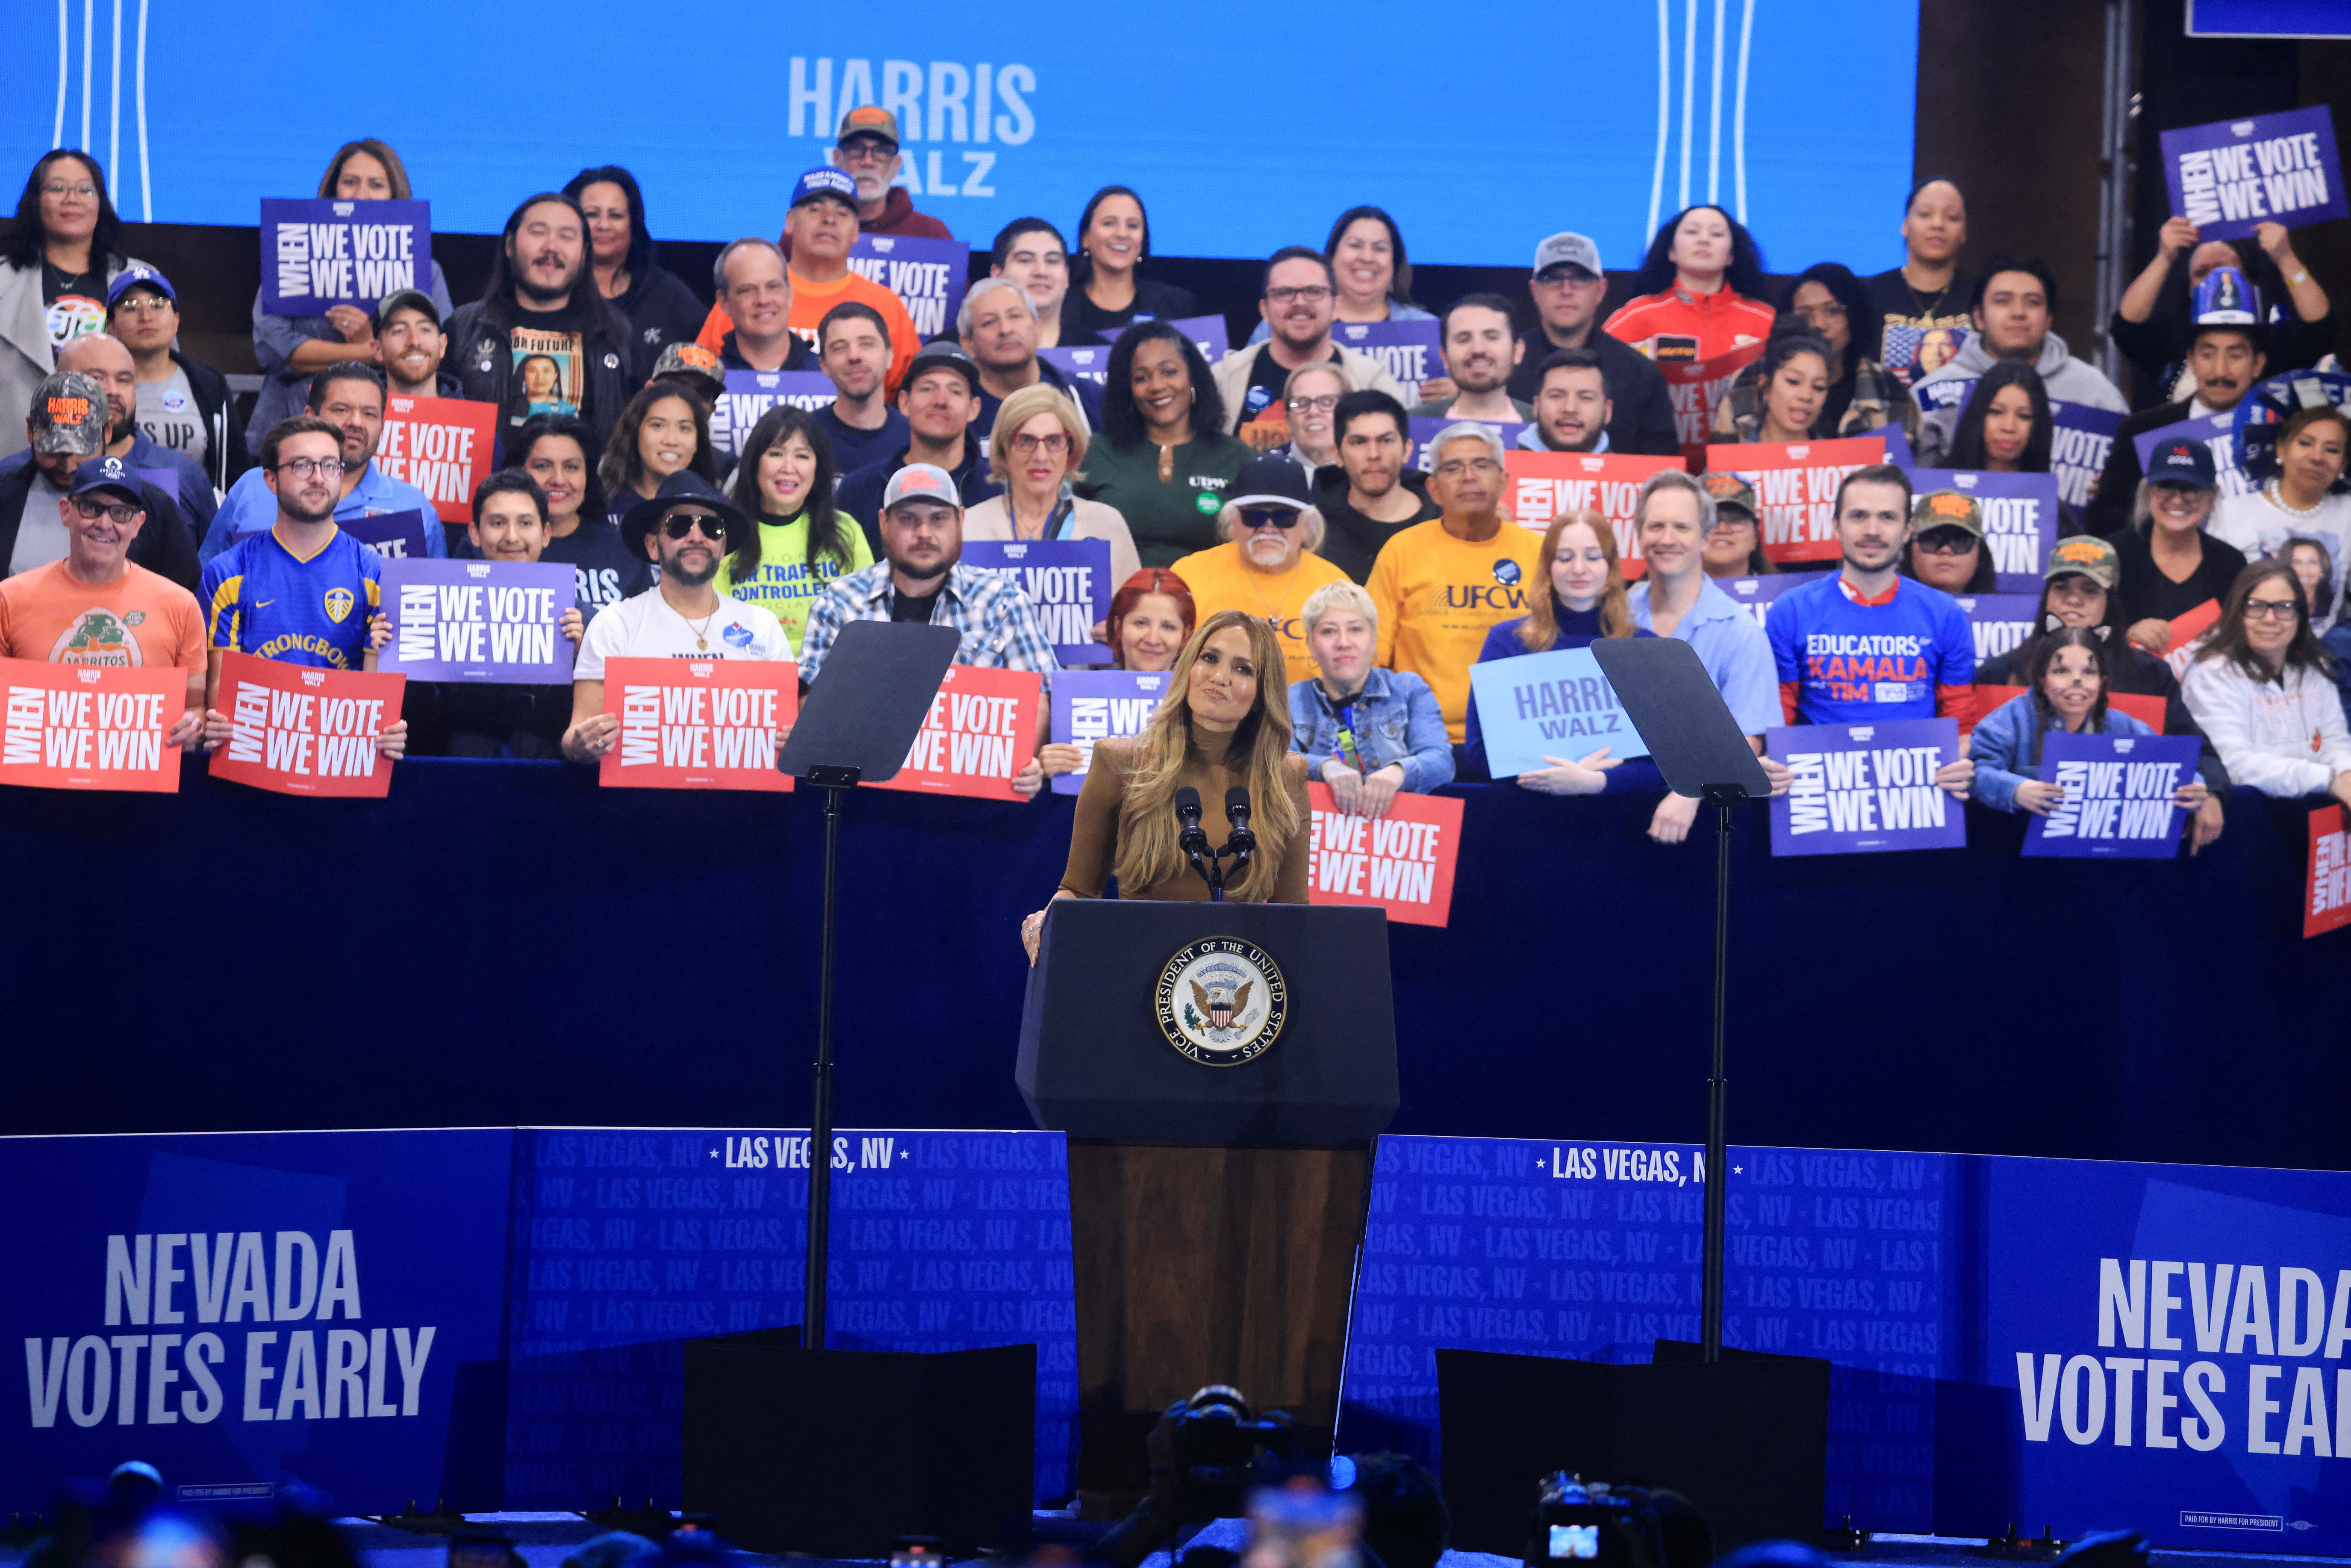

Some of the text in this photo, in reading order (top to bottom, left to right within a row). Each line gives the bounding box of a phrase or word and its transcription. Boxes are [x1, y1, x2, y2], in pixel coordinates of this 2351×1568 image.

[788, 56, 1037, 145] HARRIS
[2211, 132, 2319, 182] WE VOTE
[2179, 150, 2222, 227] WHEN
[2217, 167, 2330, 222] WE WIN
[277, 223, 309, 298] WHEN
[309, 224, 413, 260] WE VOTE
[310, 260, 414, 299] WE WIN
[890, 261, 951, 297] VOTE
[47, 397, 89, 415] HARRIS
[53, 414, 82, 424] WALZ
[165, 423, 194, 450] UP
[410, 422, 475, 463] VOTE
[410, 459, 471, 504] WIN
[1763, 468, 1803, 505] WE
[1516, 478, 1553, 536] HEN
[1763, 504, 1806, 544] WE
[467, 564, 490, 573] HARRIS
[1025, 566, 1093, 604] VOTE
[439, 586, 555, 624] WE VOTE
[1447, 585, 1532, 609] UFCW
[398, 584, 437, 662] WHEN
[438, 622, 554, 664] WE WIN
[1807, 634, 1920, 656] EDUCATORS
[77, 669, 101, 678] HARRIS
[301, 671, 325, 682] HARRIS
[690, 663, 713, 673] HARRIS
[1808, 656, 1927, 681] KAMALA
[48, 690, 165, 730] WE VOTE
[663, 687, 778, 727] WE VOTE
[1827, 682, 1869, 702] TIM
[3, 686, 46, 764] WHEN
[228, 681, 270, 763] WHEN
[271, 690, 384, 737] WE VOTE
[621, 685, 660, 766] WHEN
[951, 693, 1018, 736] VOTE
[1539, 714, 1621, 739] WALZ
[45, 726, 162, 770] WE WIN
[267, 727, 376, 777] WE WIN
[661, 725, 776, 769] WE WIN
[950, 732, 1014, 778] WIN
[1824, 747, 1941, 790] WE VOTE
[2087, 762, 2181, 799] WE VOTE
[1787, 753, 1828, 834] WHEN
[1826, 786, 1945, 833] WE WIN
[2042, 760, 2088, 838] WHEN
[1325, 812, 1369, 853] WE
[1373, 818, 1440, 862] VOTE
[2077, 799, 2174, 839] WE WIN
[1320, 850, 1435, 904] WE WIN
[2312, 835, 2330, 915] WHEN
[1159, 941, 1283, 1058] VICE PRESIDENT OF THE UNITED STATES
[726, 1137, 894, 1173] LAS VEGS, NV
[1553, 1147, 1706, 1187] LAS VEGAS, N
[104, 1229, 362, 1325] NEVADA
[24, 1326, 436, 1427] VOTES EARLY
[2016, 1352, 2226, 1451] VOTES
[2250, 1519, 2278, 1527] PRESIDENT
